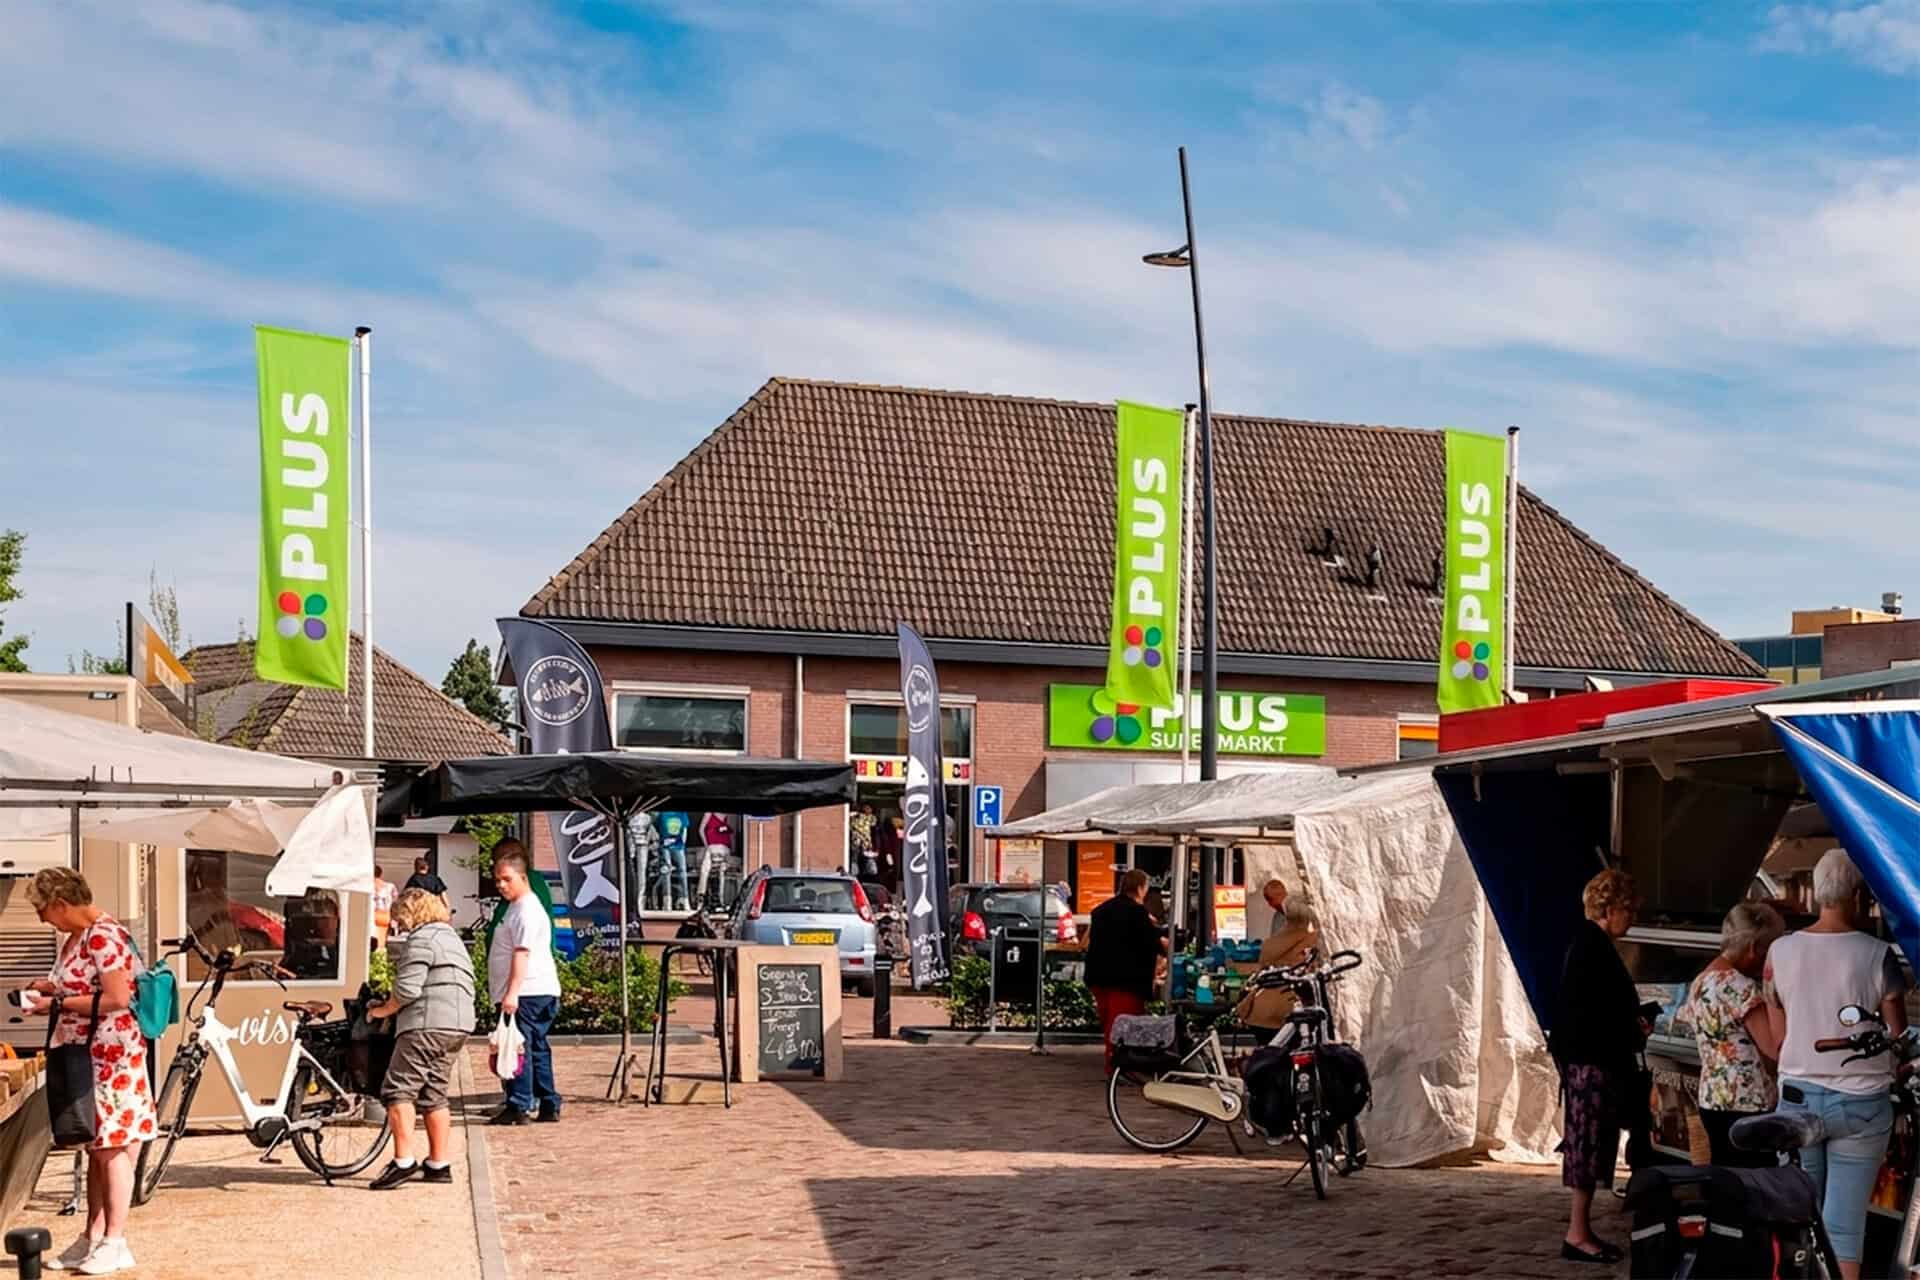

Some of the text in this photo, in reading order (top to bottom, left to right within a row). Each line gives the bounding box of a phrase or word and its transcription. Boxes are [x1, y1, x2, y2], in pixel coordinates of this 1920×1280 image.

[281, 392, 329, 581] PLUS
[1129, 457, 1167, 617] PLUS
[1457, 482, 1491, 632] PLUS
[980, 789, 997, 812] P
